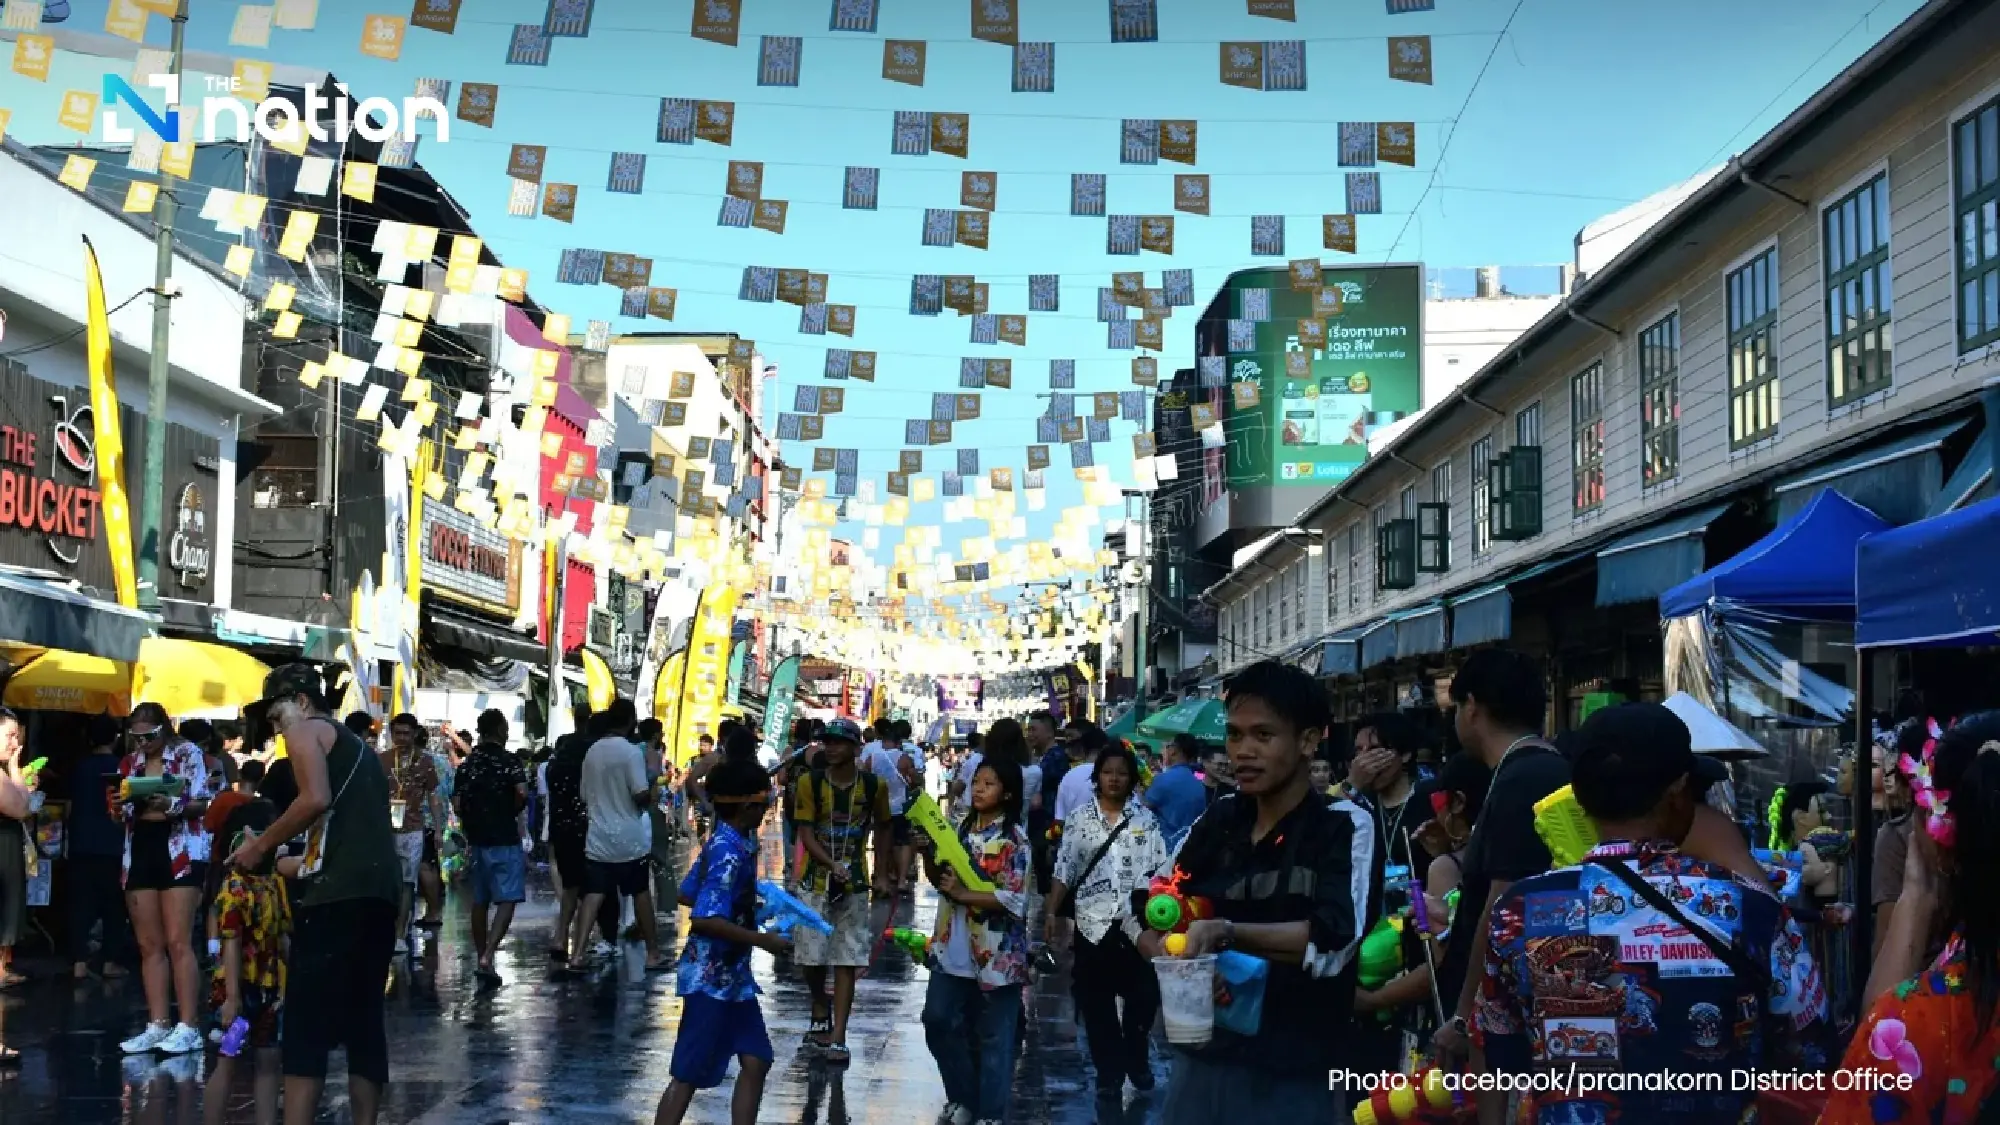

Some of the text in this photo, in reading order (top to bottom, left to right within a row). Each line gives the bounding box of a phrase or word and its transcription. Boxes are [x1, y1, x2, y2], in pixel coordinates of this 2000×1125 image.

[977, 25, 1013, 33] SINGHA
[2, 425, 37, 468] THE
[0, 469, 101, 539] BUCKET
[170, 531, 209, 578] Chang
[35, 686, 85, 700] SINGHA
